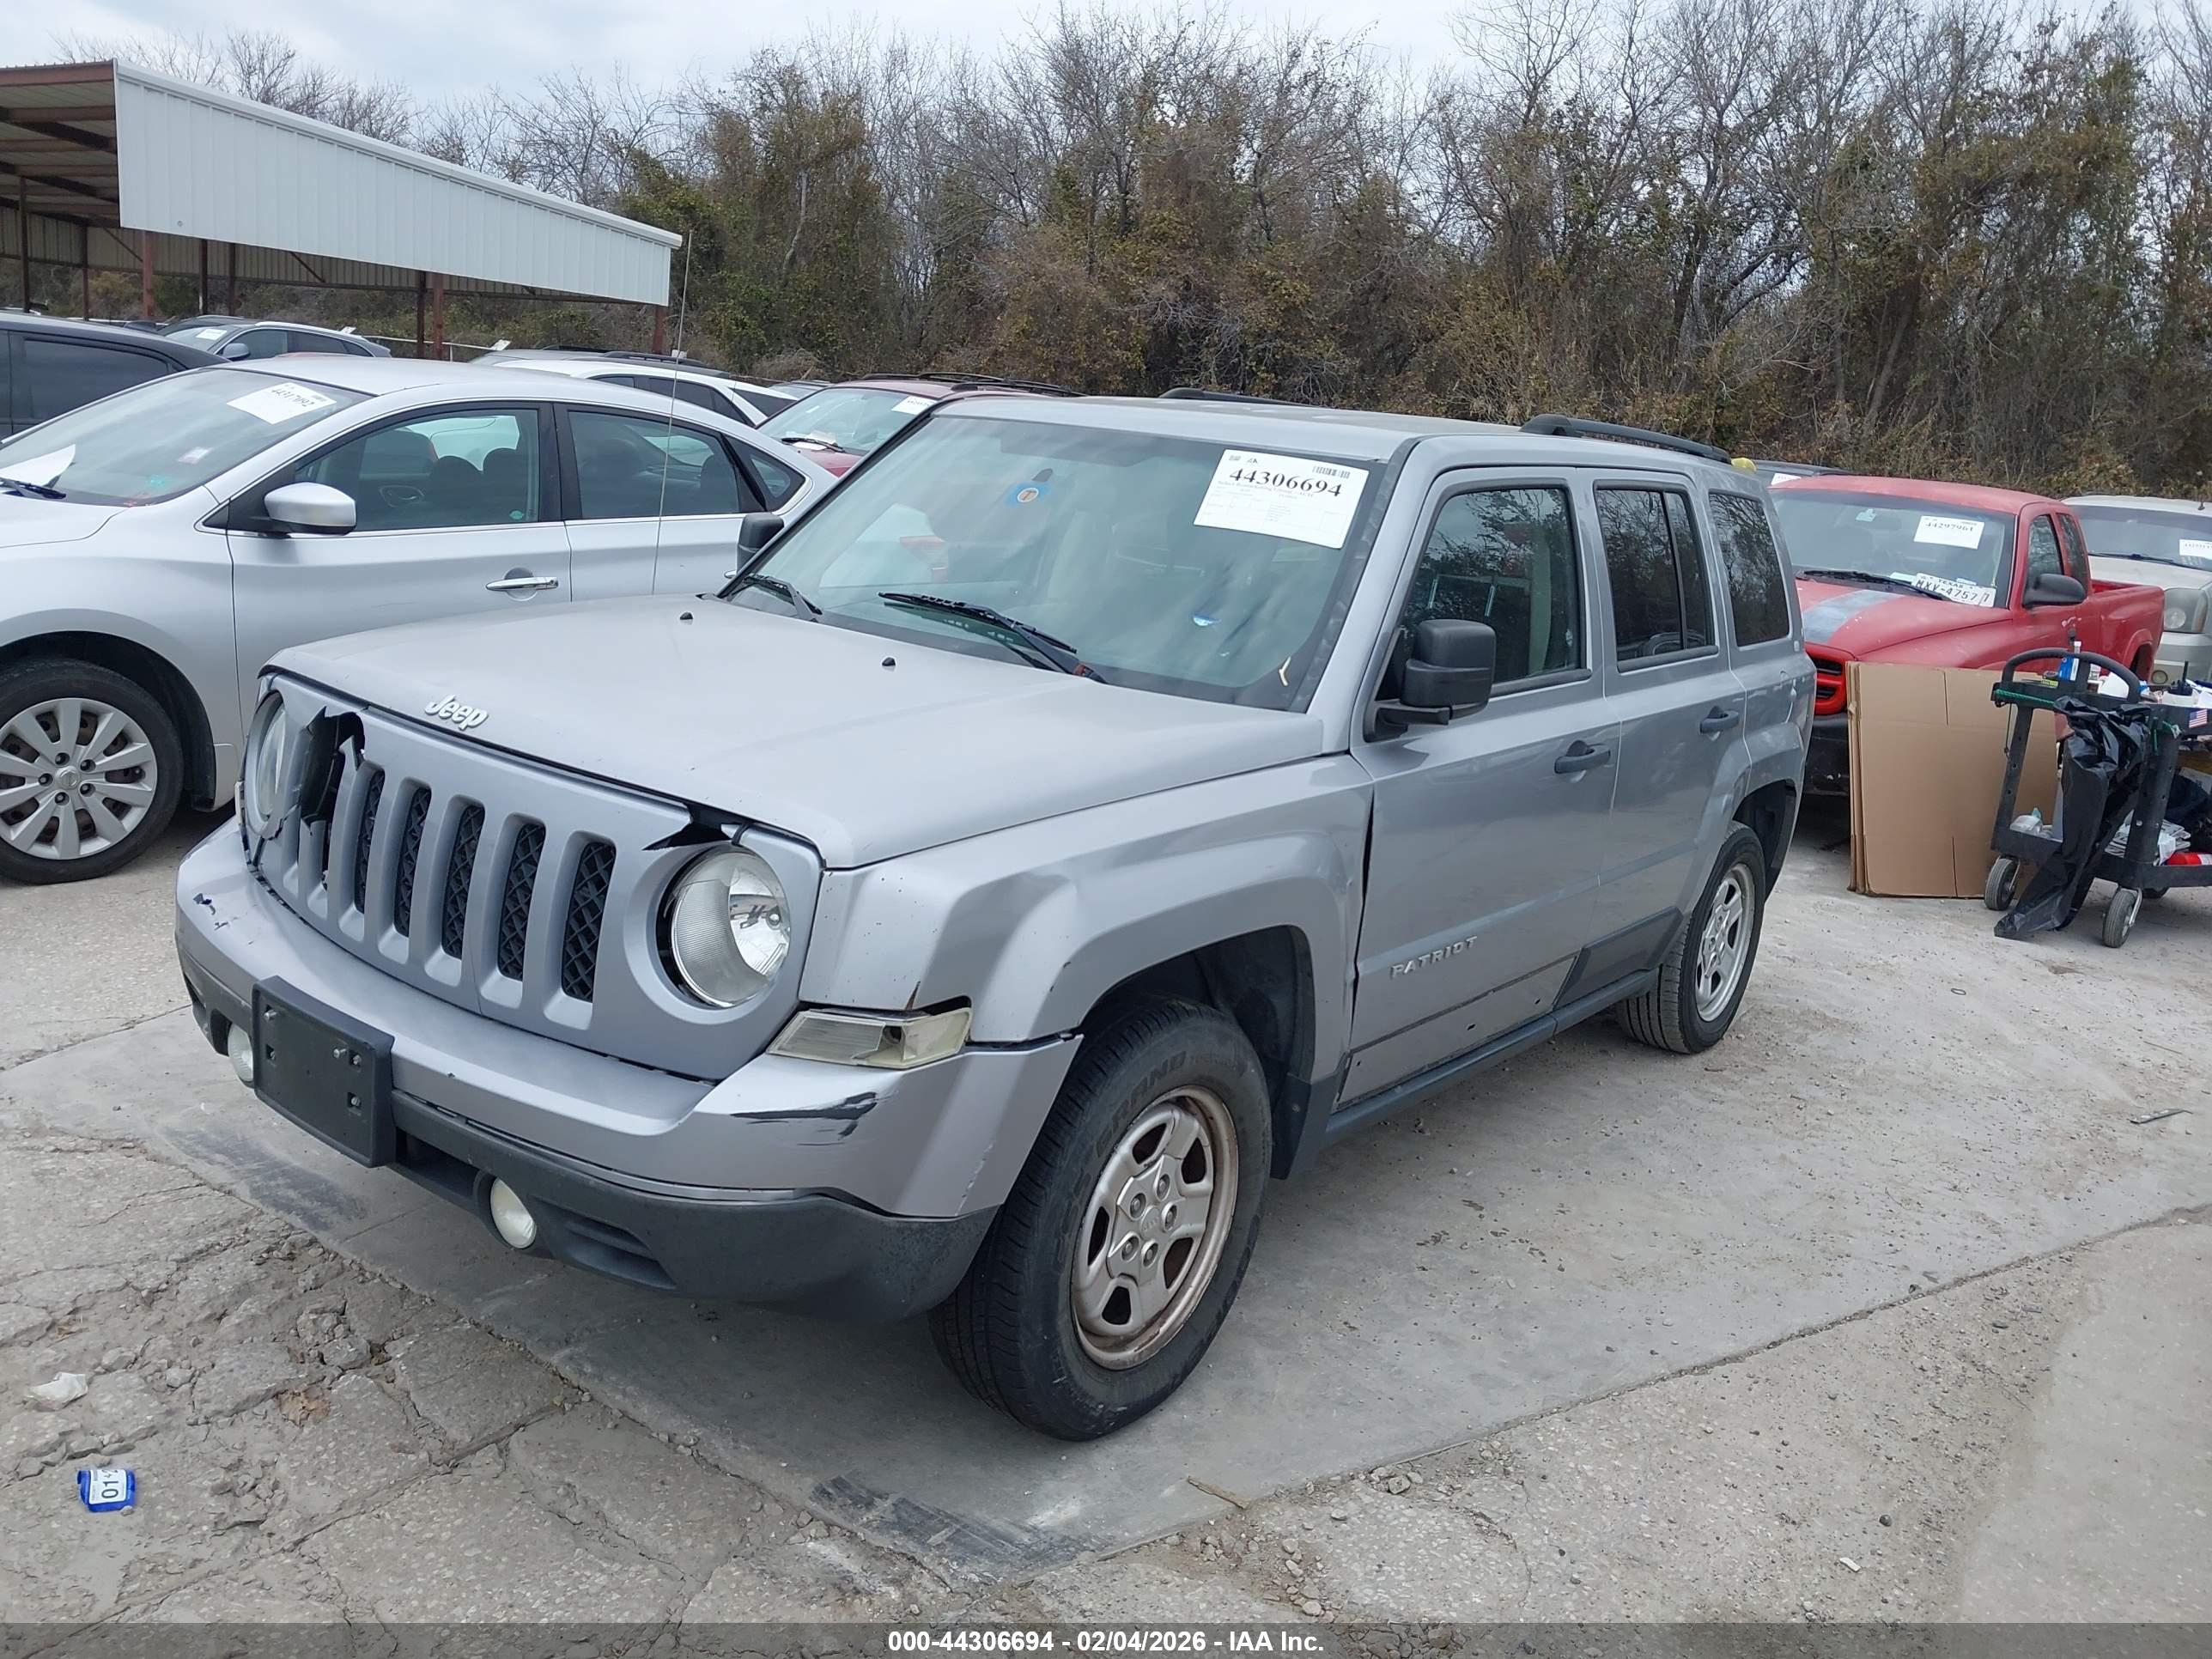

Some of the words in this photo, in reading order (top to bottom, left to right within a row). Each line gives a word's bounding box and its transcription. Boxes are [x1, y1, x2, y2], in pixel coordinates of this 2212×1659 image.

[1229, 468, 1342, 497] 44306694
[1938, 577, 1964, 588] TEXAS
[424, 694, 489, 731] Jeep
[1390, 935, 1478, 979] PATRIOT
